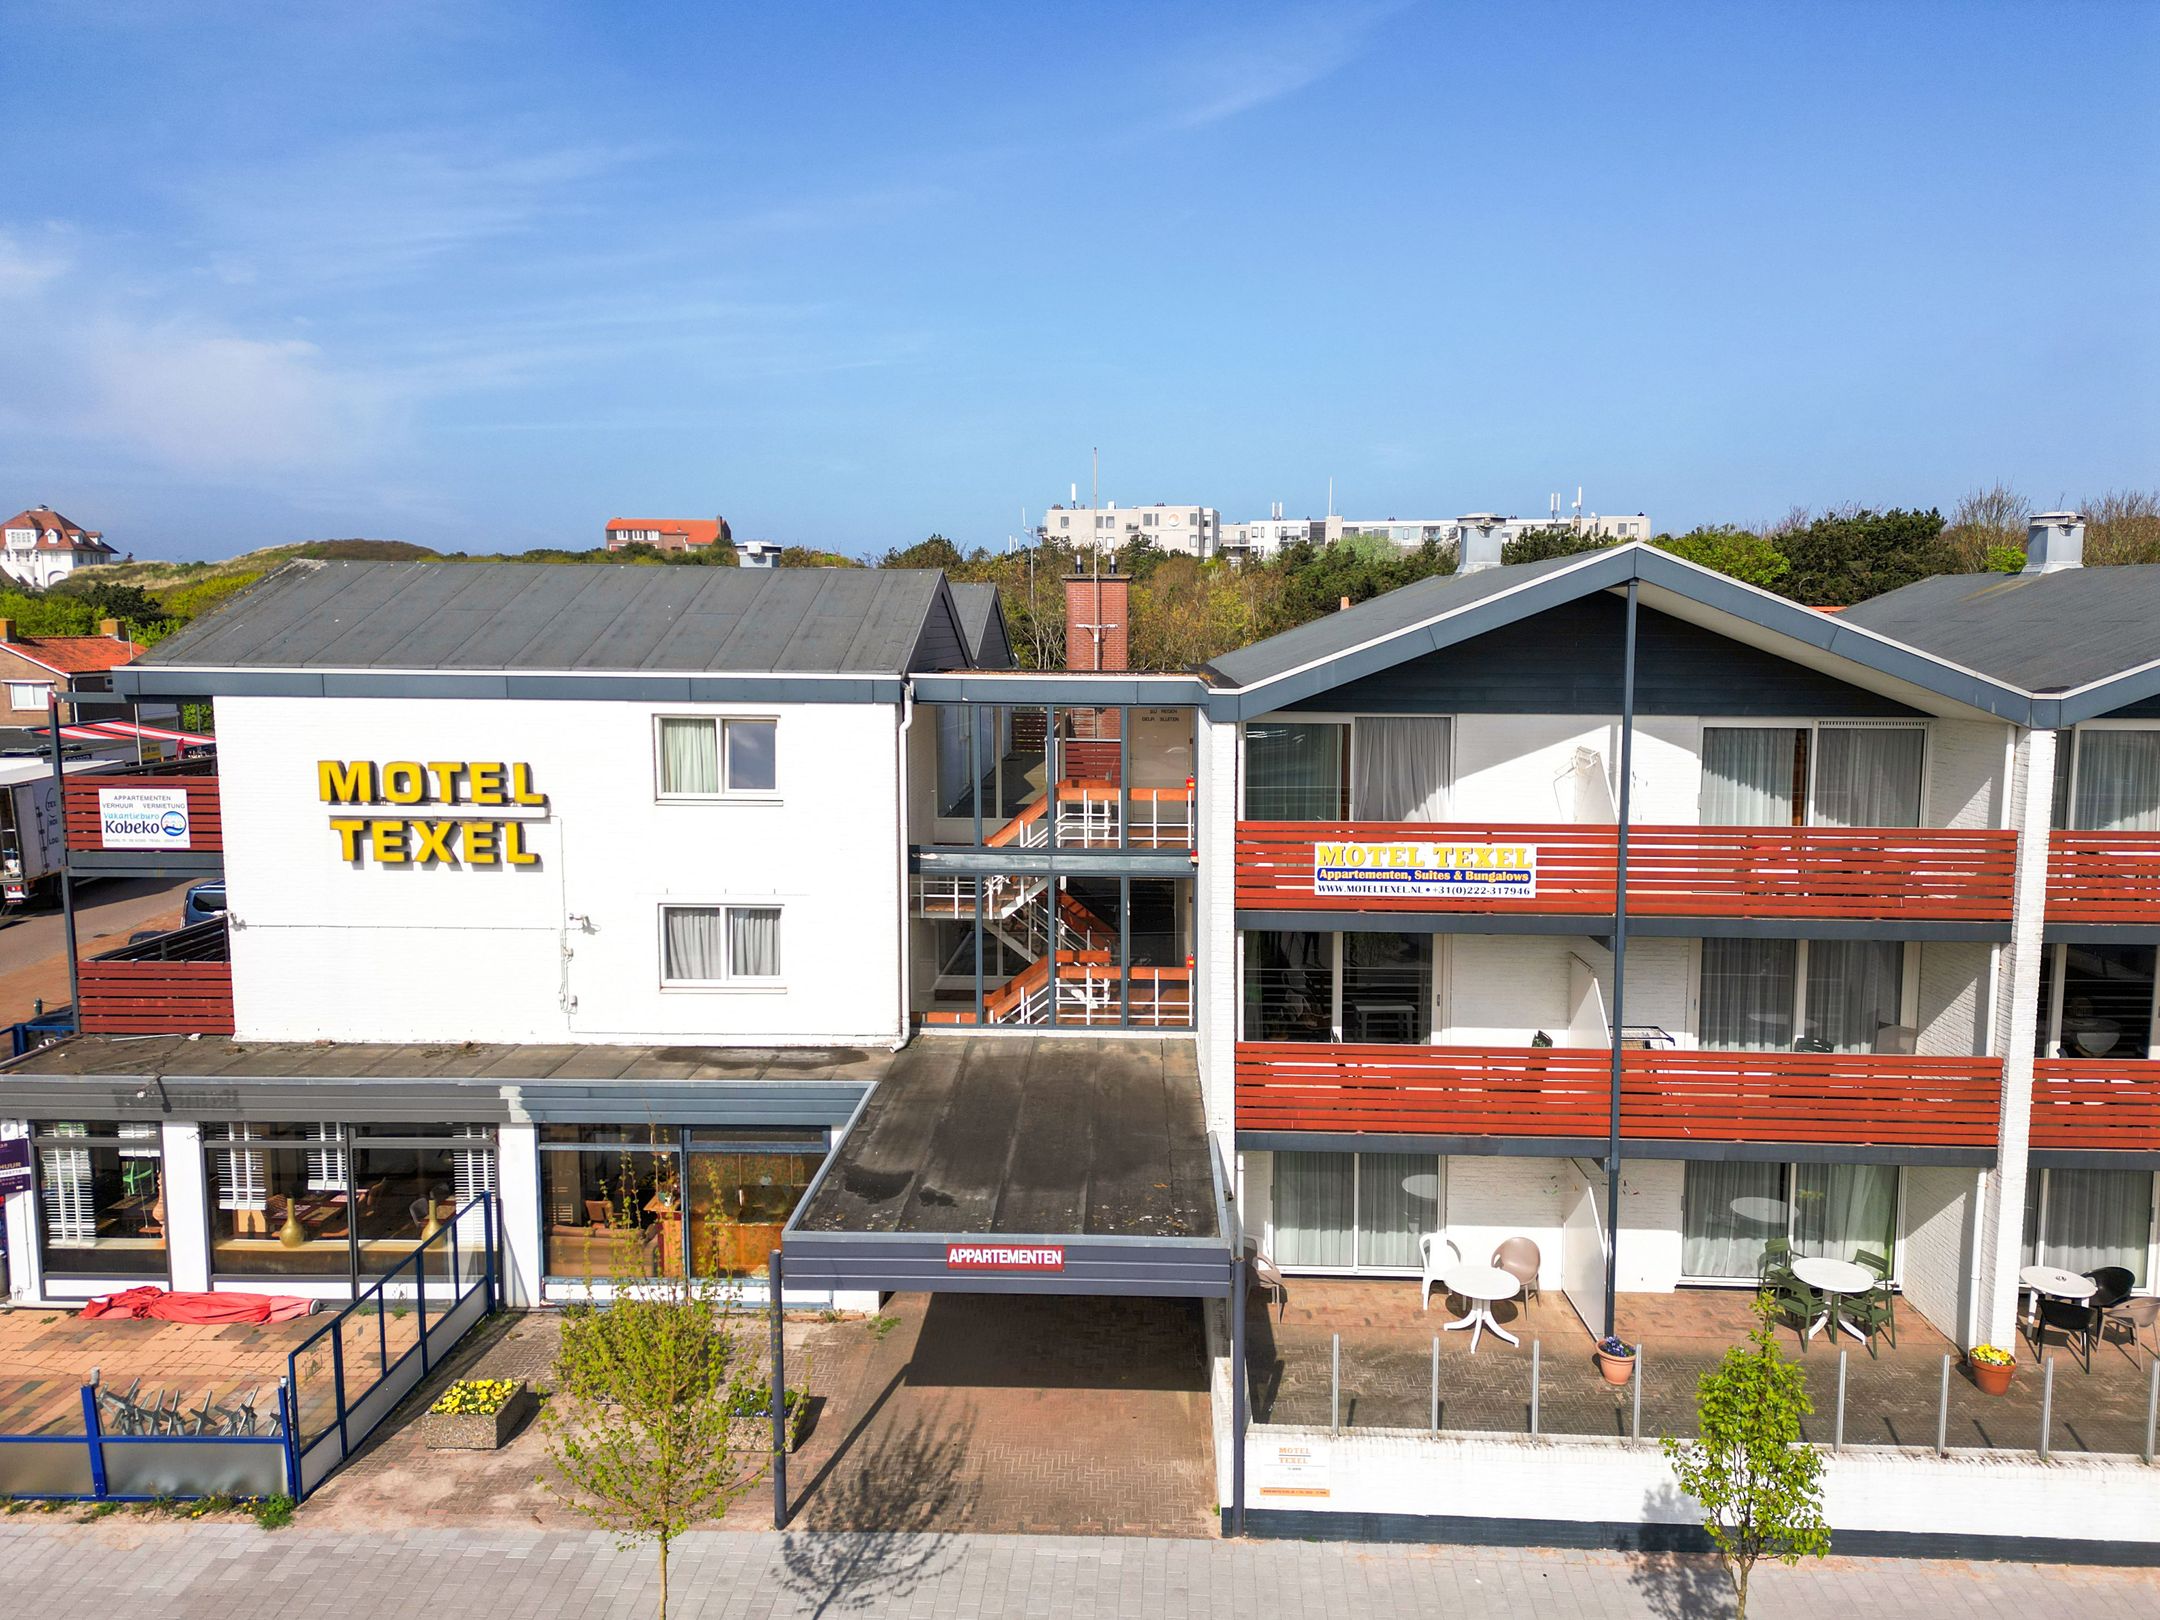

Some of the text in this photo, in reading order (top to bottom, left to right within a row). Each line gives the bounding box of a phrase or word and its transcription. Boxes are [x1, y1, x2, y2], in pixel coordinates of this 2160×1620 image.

[317, 760, 548, 805] MOTEL
[104, 812, 160, 820] Vakantieburo
[105, 820, 160, 834] Kobeko
[329, 819, 543, 864] TEXEL
[1317, 845, 1533, 869] MOTEL TEXEL
[1319, 869, 1529, 882] Appartementen, Suites & Bungalows
[1318, 884, 1530, 895] WWW.MOTELTEXEL.NL +31(0)222-317946
[949, 1248, 1062, 1264] APPARTEMENTEN
